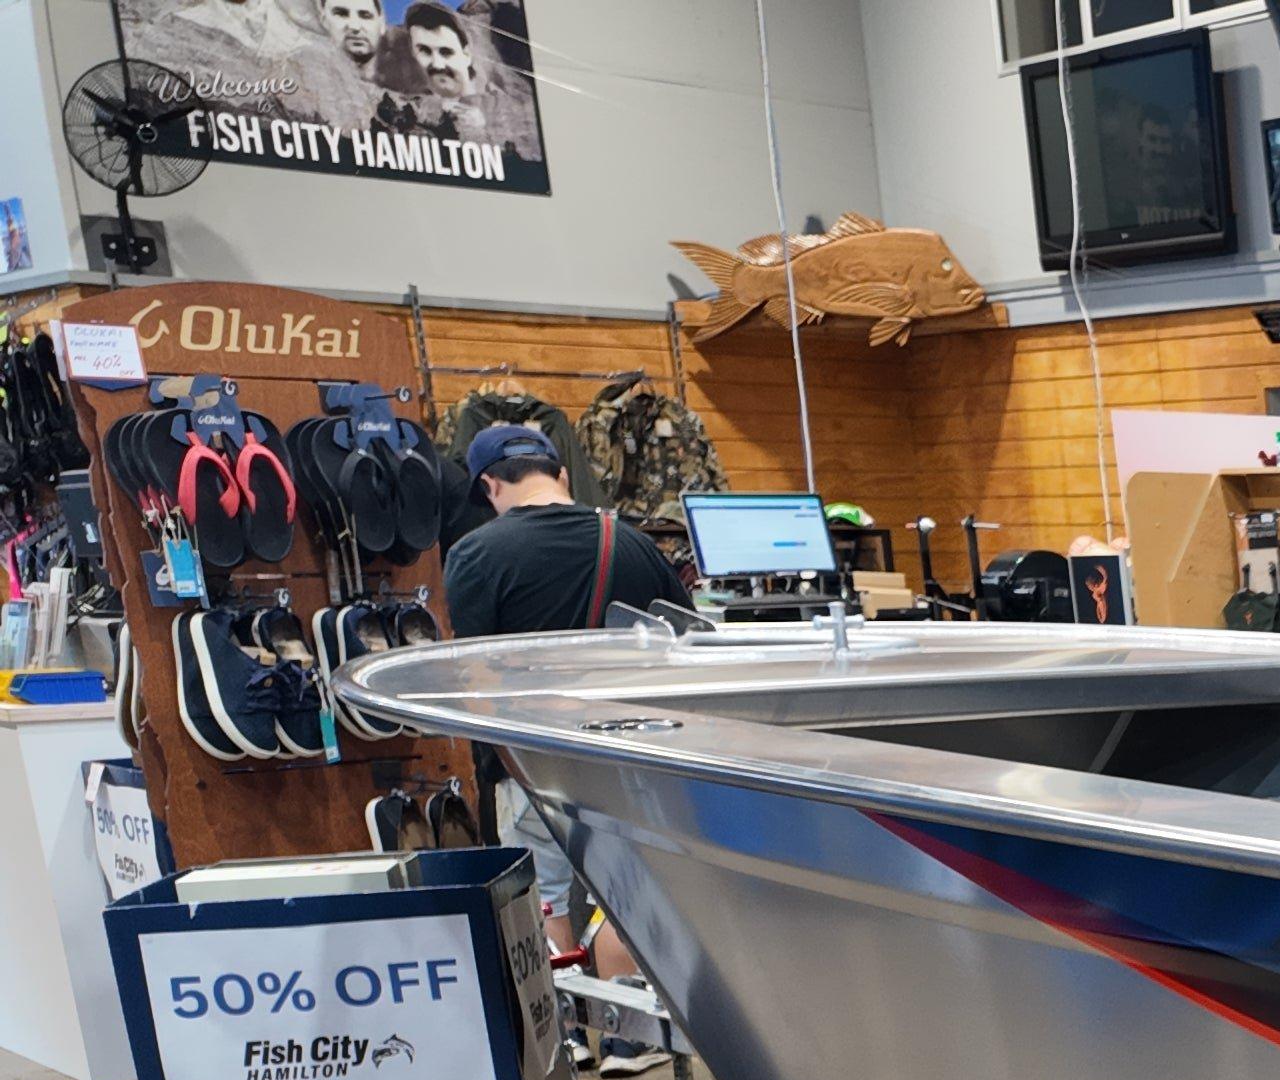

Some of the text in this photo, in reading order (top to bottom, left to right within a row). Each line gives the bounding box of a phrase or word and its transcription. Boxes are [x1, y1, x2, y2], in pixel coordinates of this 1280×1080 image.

[146, 69, 299, 102] Welcome
[258, 98, 276, 114] to
[187, 109, 506, 181] FISH CITY HAMILTON
[179, 304, 361, 358] OluKai
[93, 354, 122, 371] 40%
[122, 813, 150, 846] OFF
[170, 958, 458, 1019] 50% OFF
[243, 1034, 369, 1068] Fish City
